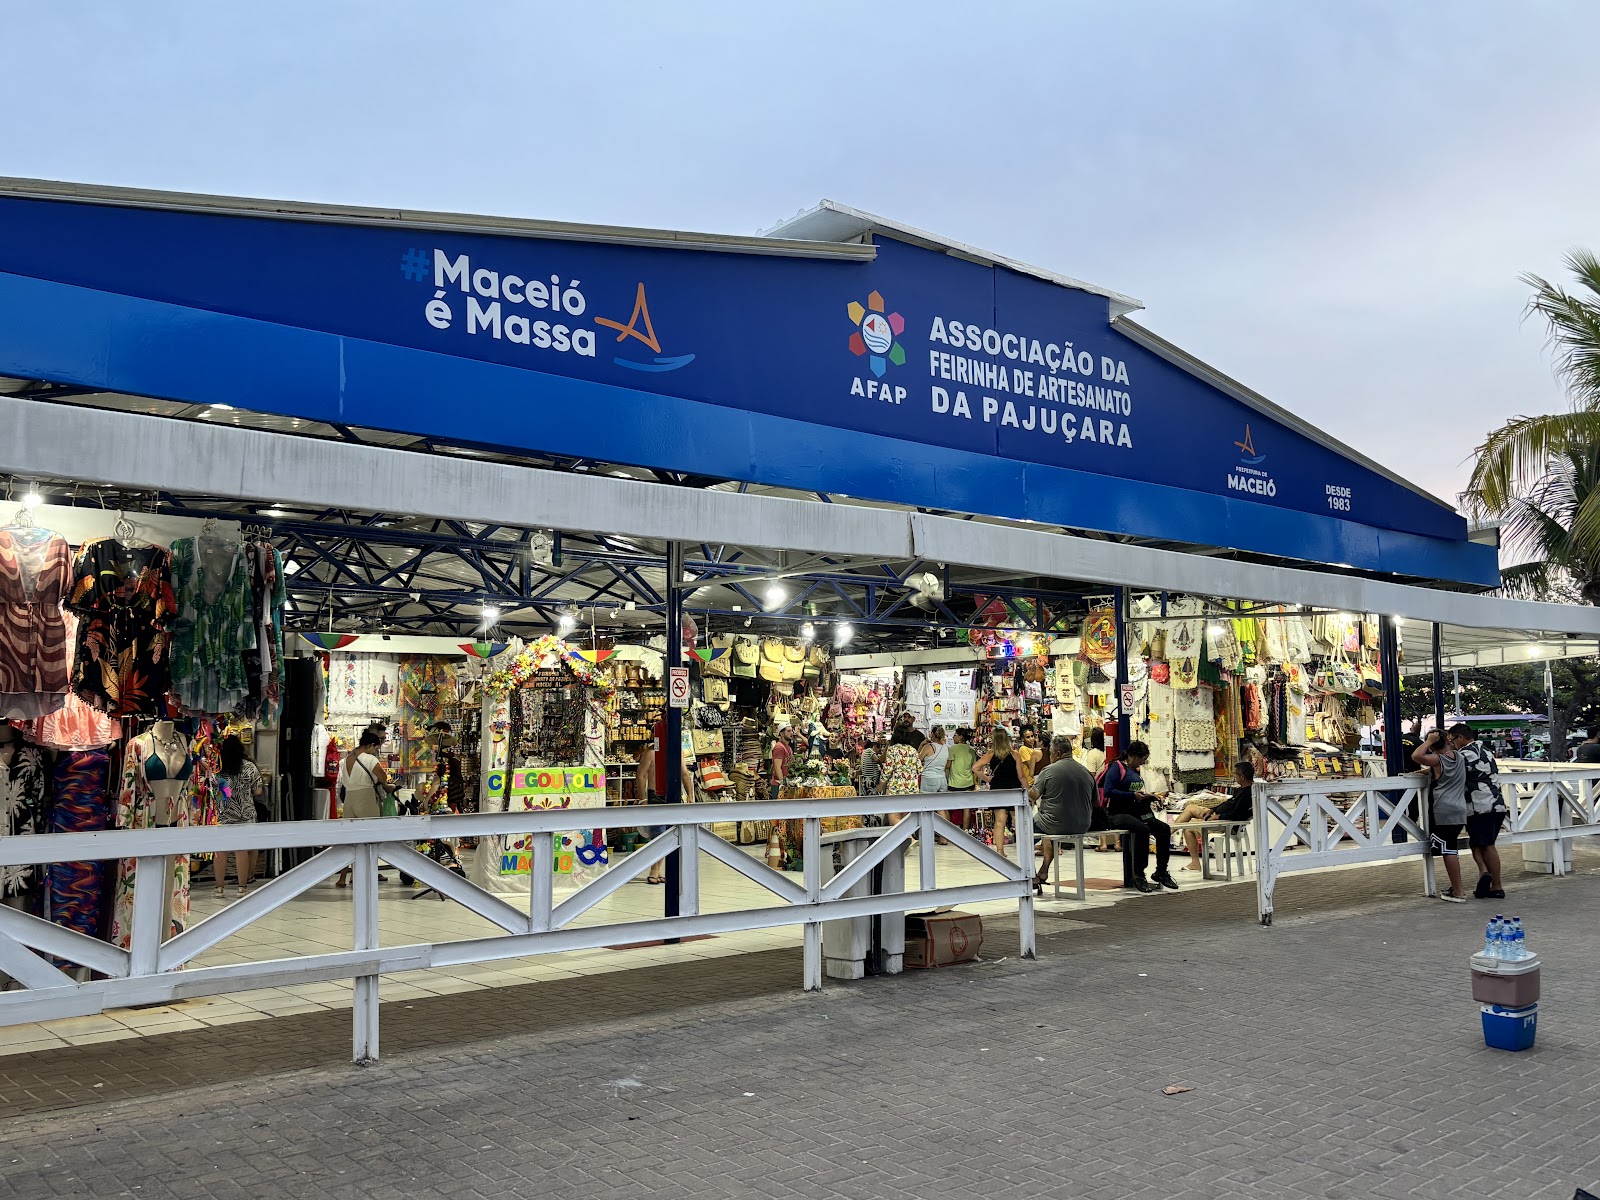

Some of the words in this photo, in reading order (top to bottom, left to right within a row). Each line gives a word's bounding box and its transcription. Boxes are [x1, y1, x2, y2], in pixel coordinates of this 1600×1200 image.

[400, 247, 587, 316] #Maceió
[425, 290, 452, 329] é
[466, 296, 596, 358] Massa
[929, 316, 1094, 376] ASSOCIAÇÃO
[1101, 356, 1130, 386] DA
[850, 377, 908, 405] AFAP
[930, 350, 1009, 393] FEIRINHA
[1013, 368, 1034, 398] DE
[1037, 374, 1132, 417] ARTESANATO
[931, 385, 972, 419] DA
[983, 396, 1133, 449] PAJUÇARA
[1235, 466, 1261, 476] PREFEITURA
[1227, 473, 1277, 498] MACEIÓ
[1325, 484, 1351, 498] DESDE
[1327, 496, 1351, 512] 1983
[564, 773, 606, 789] FOLIA
